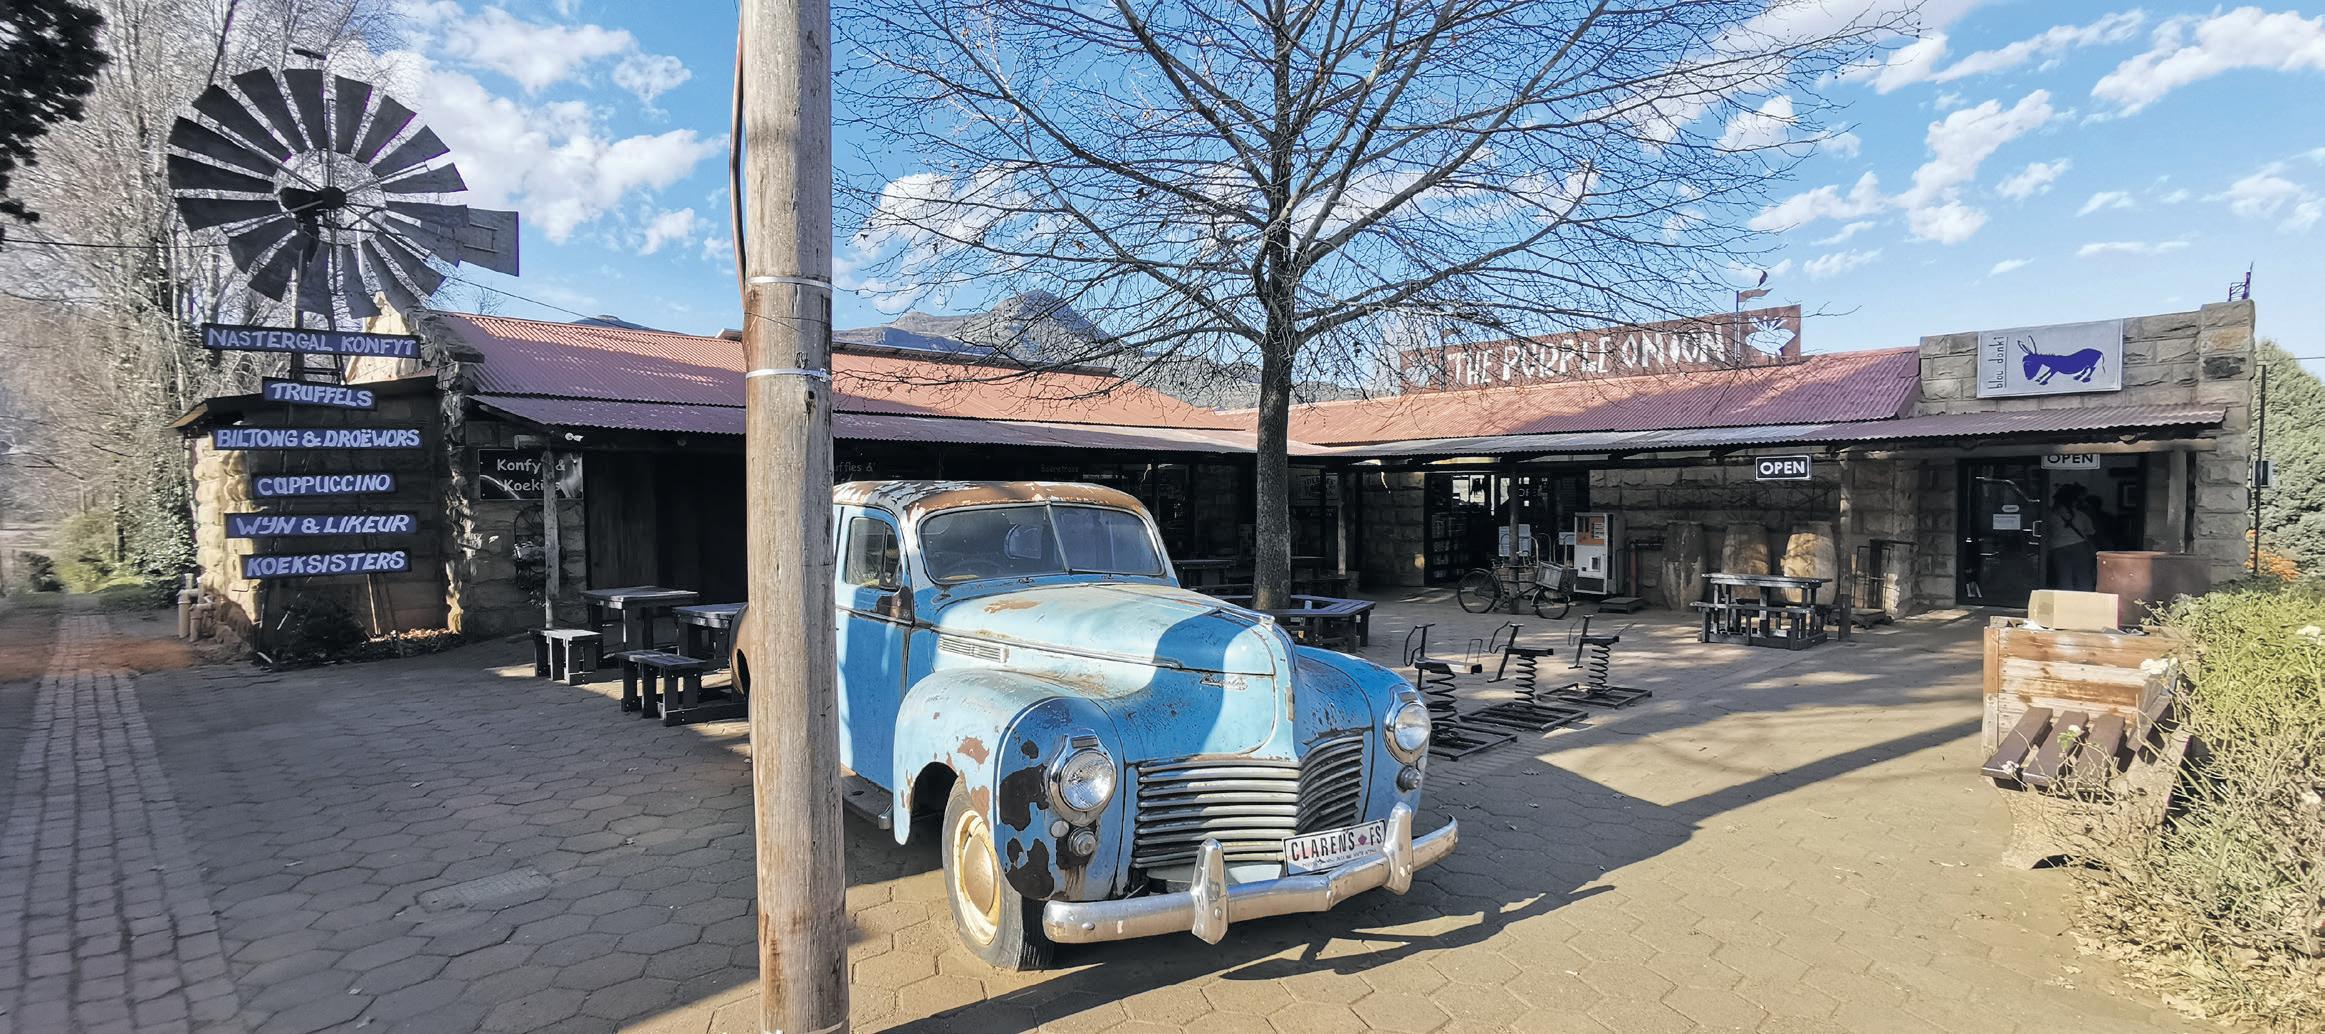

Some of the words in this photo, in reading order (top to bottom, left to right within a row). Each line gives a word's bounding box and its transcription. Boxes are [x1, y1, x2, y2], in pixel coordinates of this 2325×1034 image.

[207, 328, 333, 351] NASTERGAL
[341, 336, 416, 355] KONFYT
[1987, 336, 2004, 364] donki
[1447, 349, 1492, 385] THE
[1502, 337, 1611, 381] PURPLE
[1619, 323, 1725, 369] ONION
[1987, 370, 2004, 390] blou
[270, 382, 374, 407] TRUFFELS
[217, 428, 298, 447] BILTONG
[302, 430, 322, 446] &
[323, 429, 420, 447] DROËWORS
[497, 458, 545, 474] Konfy
[555, 459, 566, 471] &
[1760, 461, 1805, 475] OPEN
[2047, 453, 2093, 464] OPEN
[257, 475, 391, 496] CAPPUCCINO
[504, 479, 561, 491] Koekis
[236, 517, 296, 535] WYN
[301, 518, 320, 534] &
[323, 514, 409, 534] LIKEUR
[246, 551, 405, 577] KOEKSISTERS
[1291, 831, 1355, 861] CLARENS
[1369, 825, 1382, 846] FS
